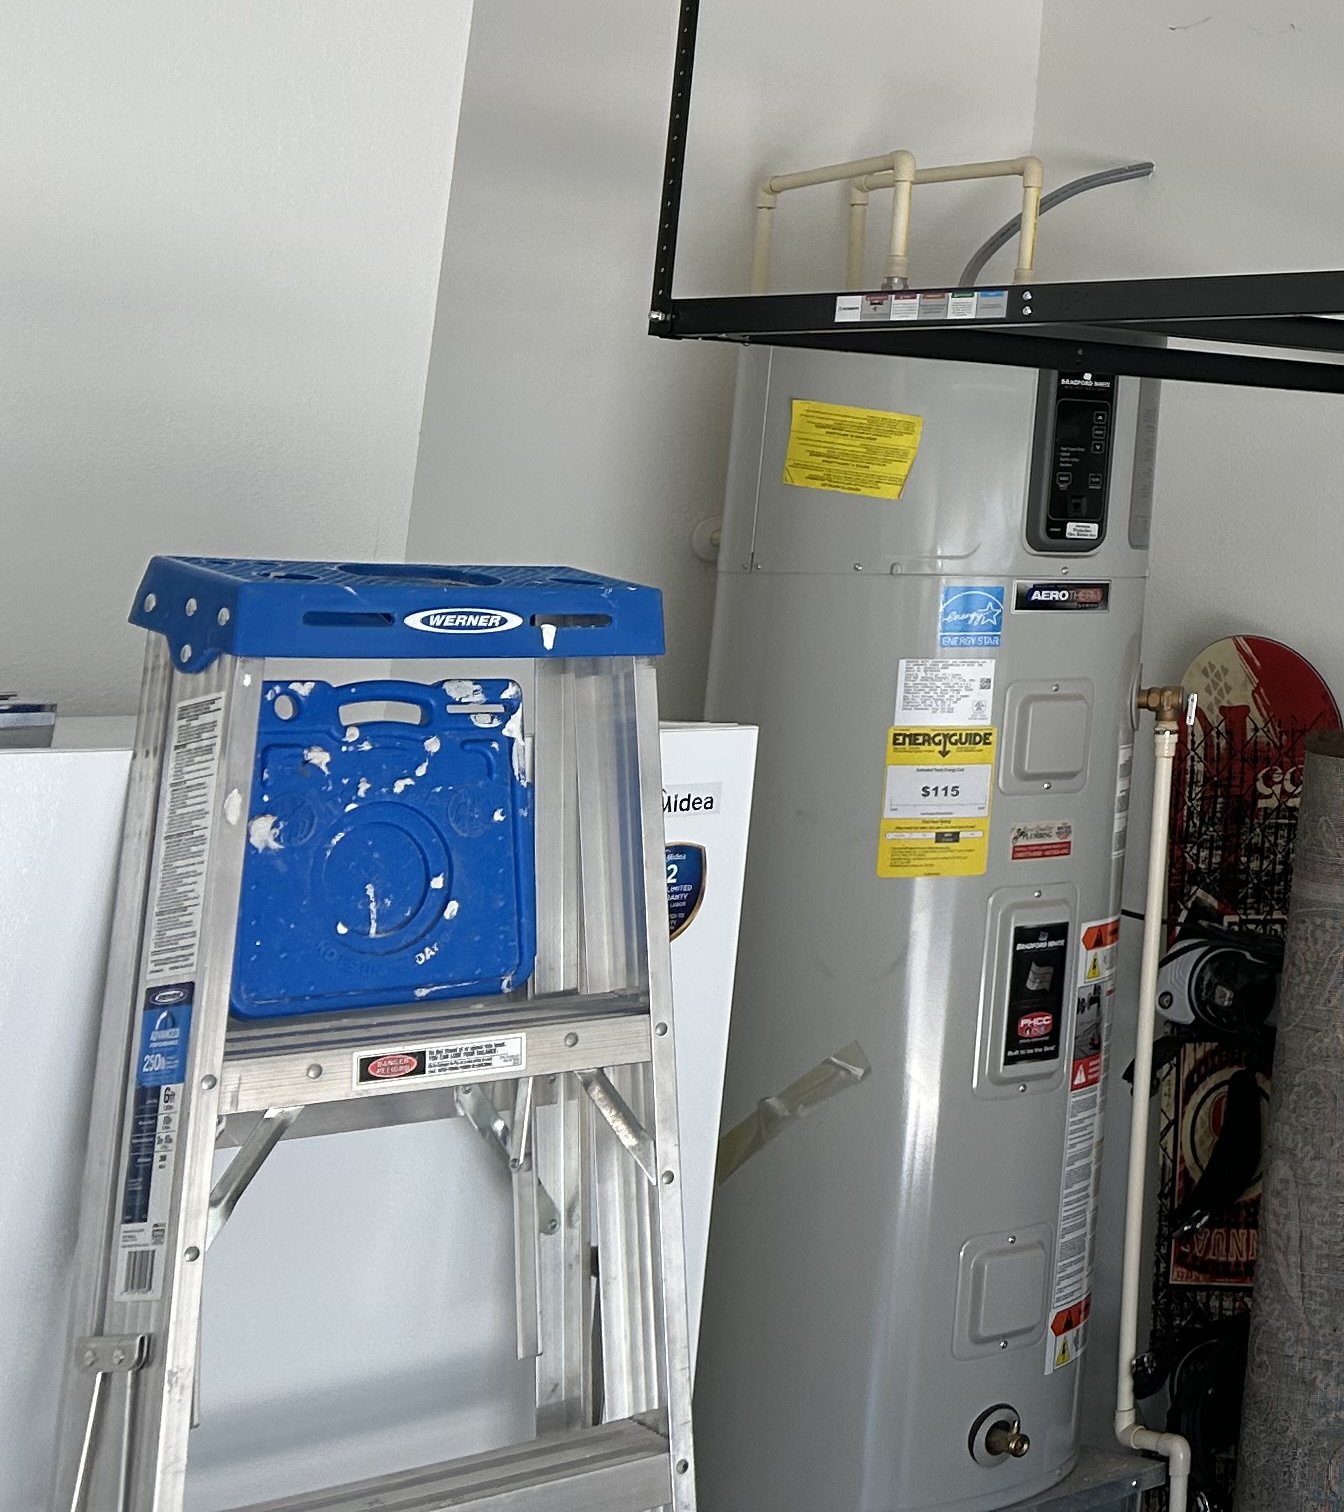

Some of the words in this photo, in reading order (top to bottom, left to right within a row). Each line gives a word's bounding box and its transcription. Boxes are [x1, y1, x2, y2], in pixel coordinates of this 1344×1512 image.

[429, 615, 502, 626] WERNER
[941, 637, 975, 646] ENERGY
[978, 637, 1000, 646] STAR
[921, 785, 960, 797] $115
[667, 864, 679, 884] 2
[1020, 1016, 1052, 1028] PHCC
[377, 1058, 410, 1068] DANGER
